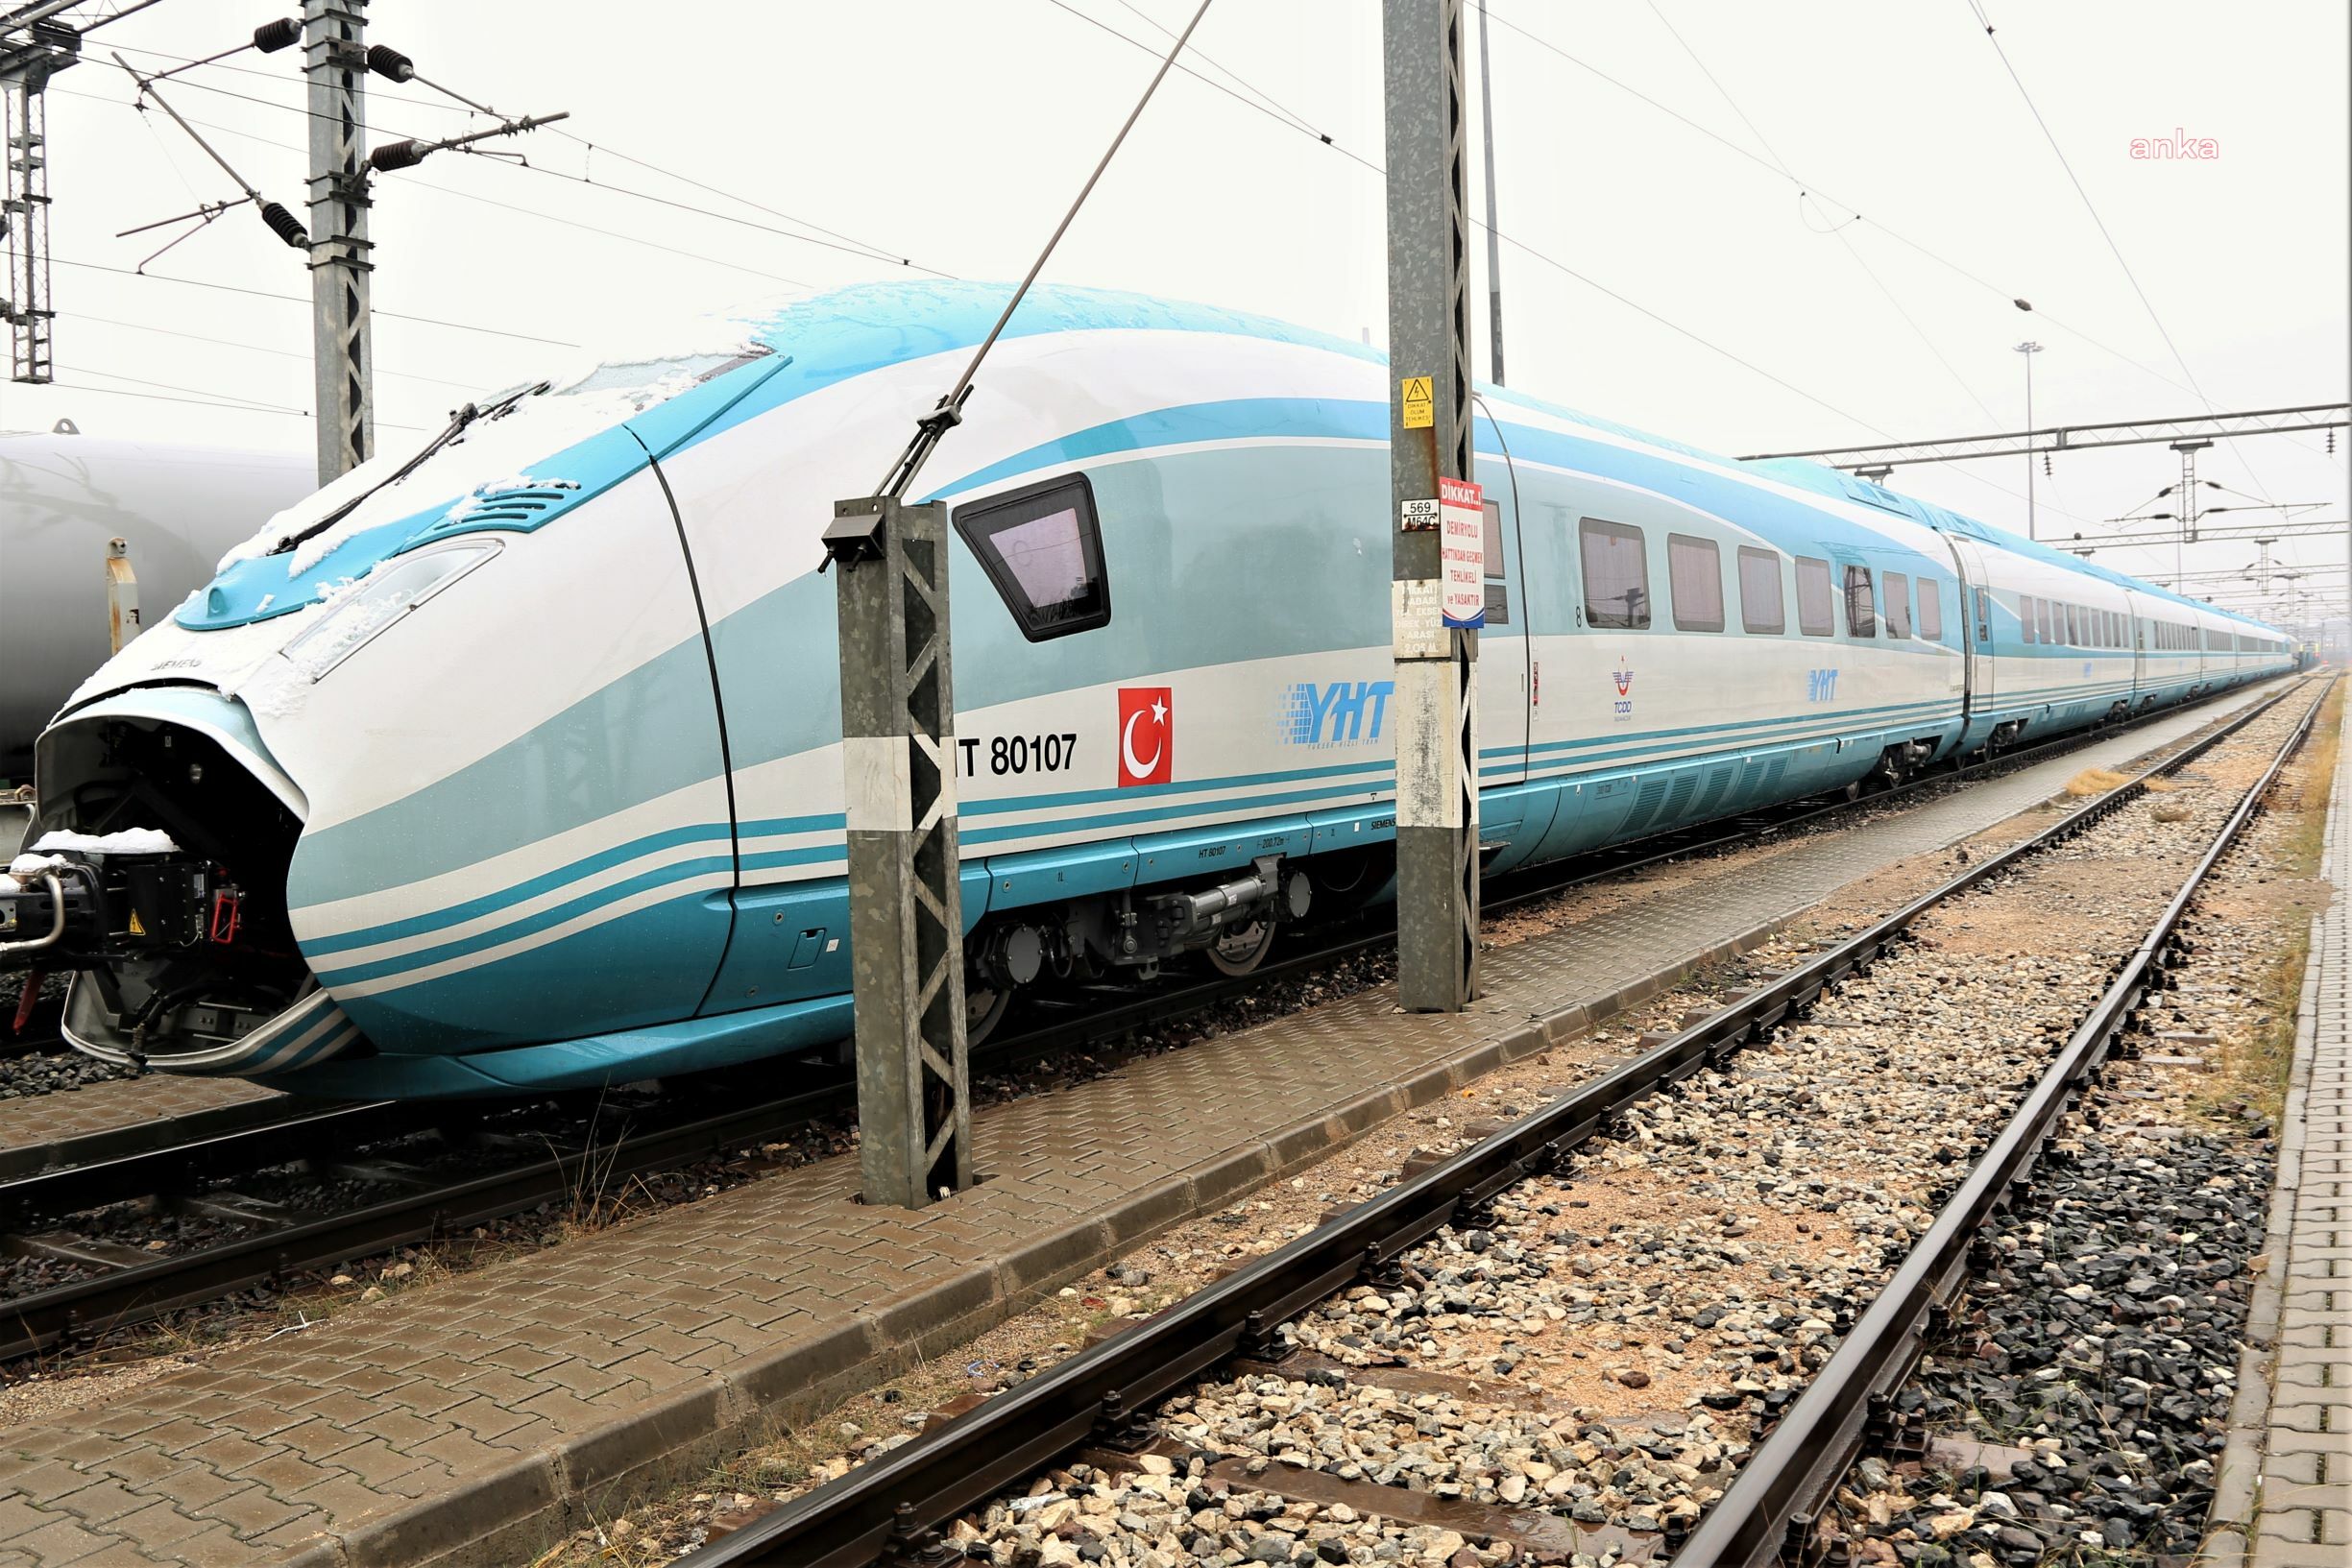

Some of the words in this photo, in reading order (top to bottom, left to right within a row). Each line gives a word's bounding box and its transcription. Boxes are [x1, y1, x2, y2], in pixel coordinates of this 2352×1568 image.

[1410, 502, 1431, 513] 569
[1446, 519, 1479, 539] DEMİRYOLU
[1450, 568, 1477, 584] TEHLİKELİ
[1447, 594, 1453, 605] ve
[1454, 593, 1480, 606] YASAKTIR
[1576, 606, 1582, 628] 8
[1303, 681, 1395, 744] YHT
[1614, 701, 1632, 713] TCDD
[954, 738, 980, 778] T
[990, 733, 1078, 776] 80107
[1370, 817, 1396, 831] SIEMENS
[1199, 848, 1208, 858] HT
[1208, 845, 1226, 856] 80107
